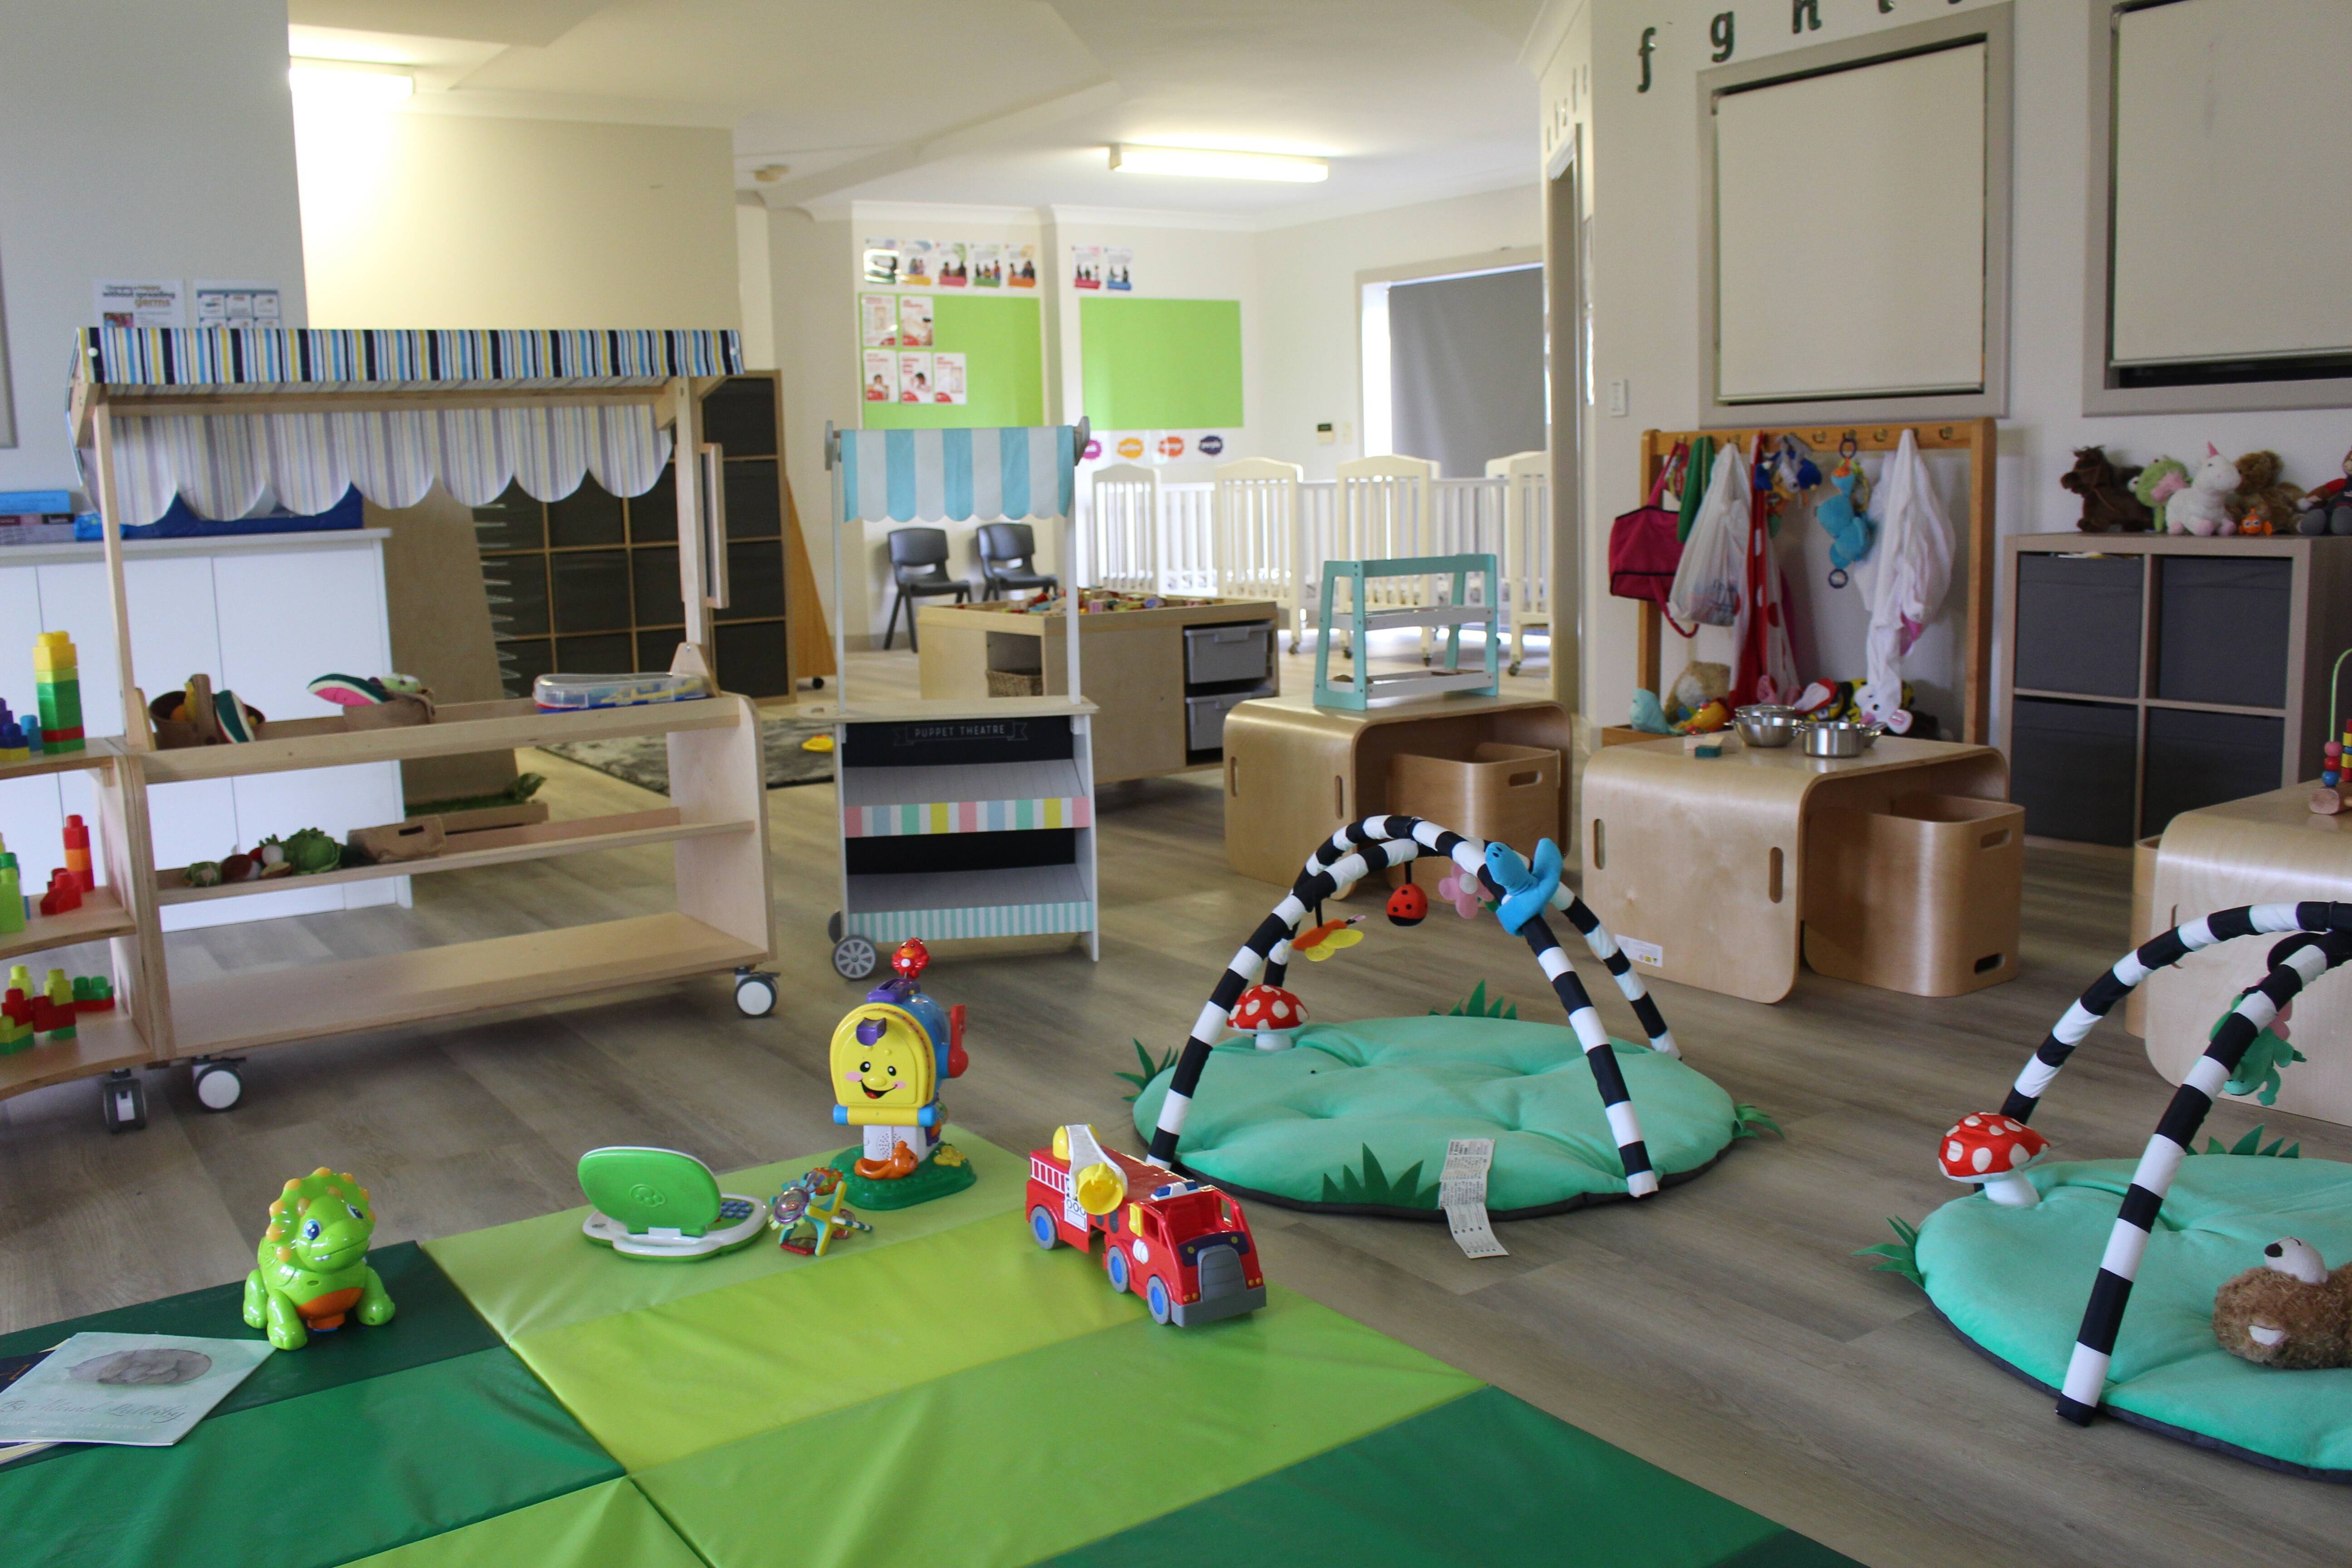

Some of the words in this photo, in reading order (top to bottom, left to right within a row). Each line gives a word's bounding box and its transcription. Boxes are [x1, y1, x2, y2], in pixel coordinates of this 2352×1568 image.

[1637, 27, 1656, 93] f
[1710, 11, 1734, 62] g
[915, 727, 954, 737] PUPPET
[960, 724, 1005, 735] THEATRE
